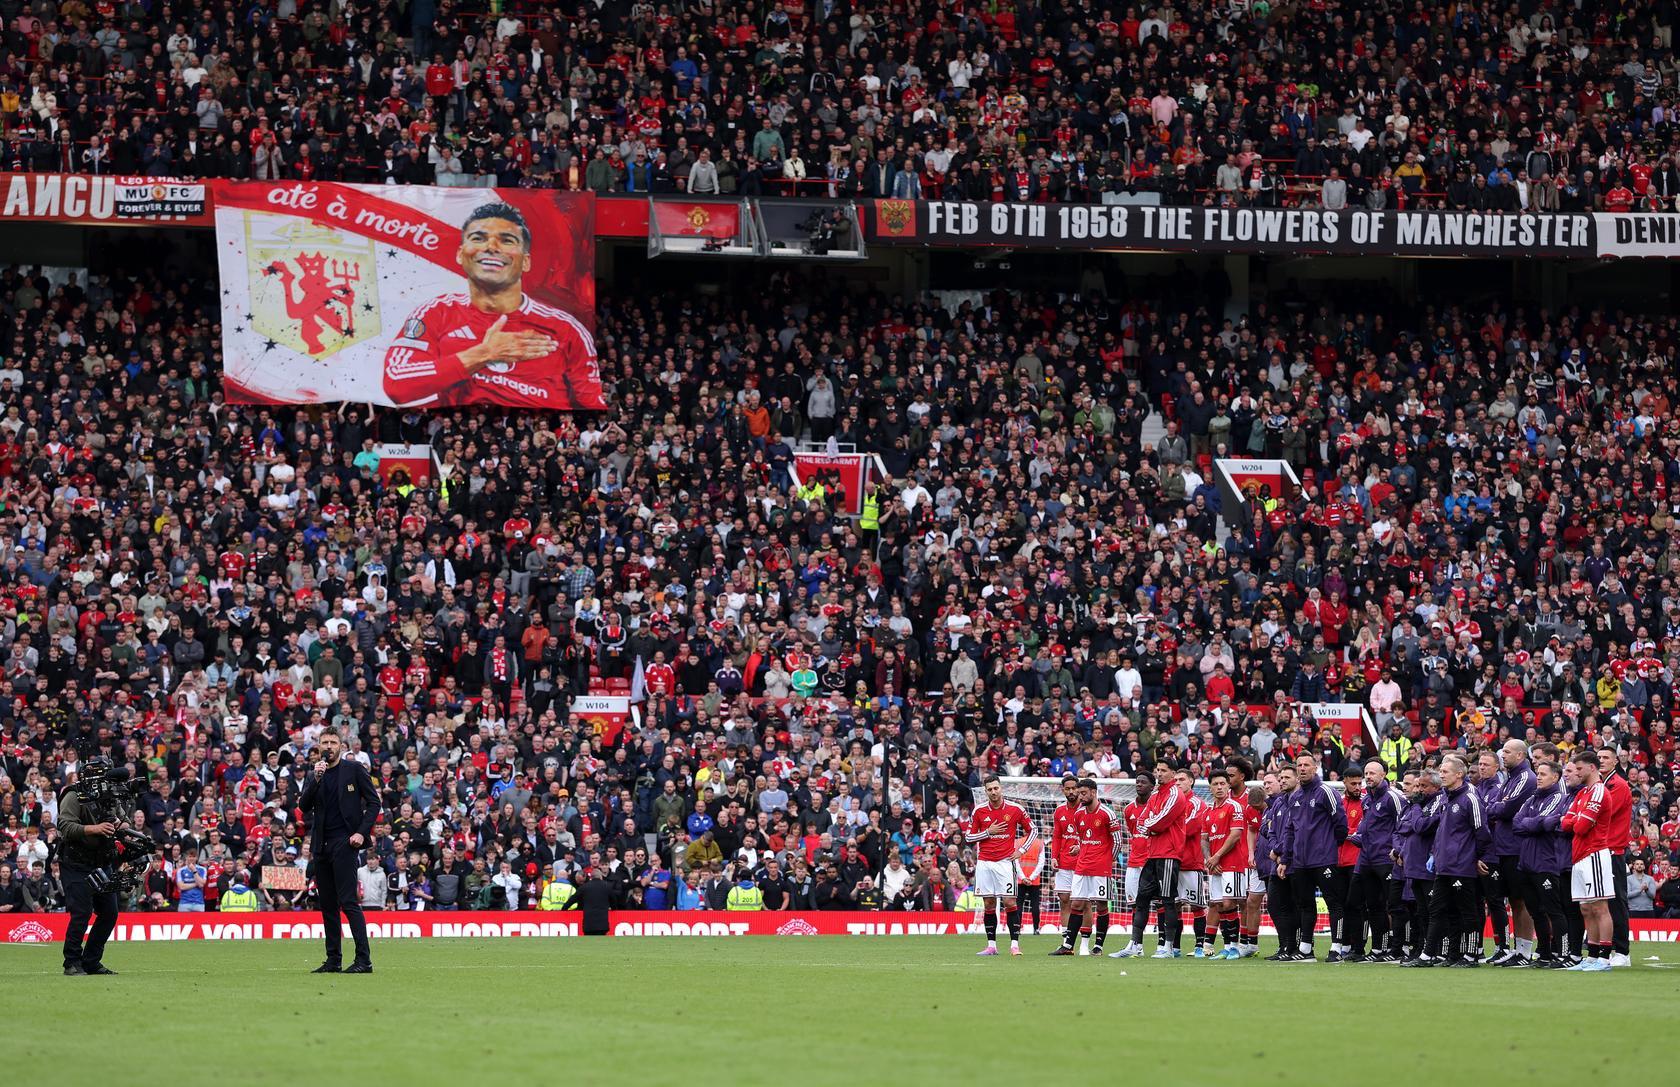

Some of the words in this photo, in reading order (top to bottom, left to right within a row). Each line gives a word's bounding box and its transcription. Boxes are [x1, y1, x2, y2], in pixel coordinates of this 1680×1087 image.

[125, 188, 148, 199] MU
[170, 187, 189, 198] FC
[119, 203, 162, 213] FOREVER
[164, 204, 172, 212] &
[174, 203, 201, 212] EVER
[267, 183, 319, 209] até
[326, 194, 349, 220] à
[354, 208, 439, 250] morte
[928, 201, 979, 235] FEB
[990, 203, 1046, 237] 6TH
[1058, 206, 1128, 239] 1958
[1141, 207, 1193, 240] THE
[1204, 208, 1339, 243] FLOWERS
[1350, 211, 1385, 244] OF
[1396, 212, 1589, 247] MANCHESTER
[1615, 217, 1680, 244] DENI
[388, 448, 411, 456] W206
[797, 456, 814, 464] THE
[815, 457, 831, 465] RED
[832, 458, 859, 466] ARMY
[1318, 708, 1342, 716] W103
[1006, 883, 1013, 893] 2
[1098, 886, 1105, 897] 8
[1224, 882, 1232, 894] 6
[1585, 883, 1592, 895] 7
[1186, 889, 1197, 900] 25
